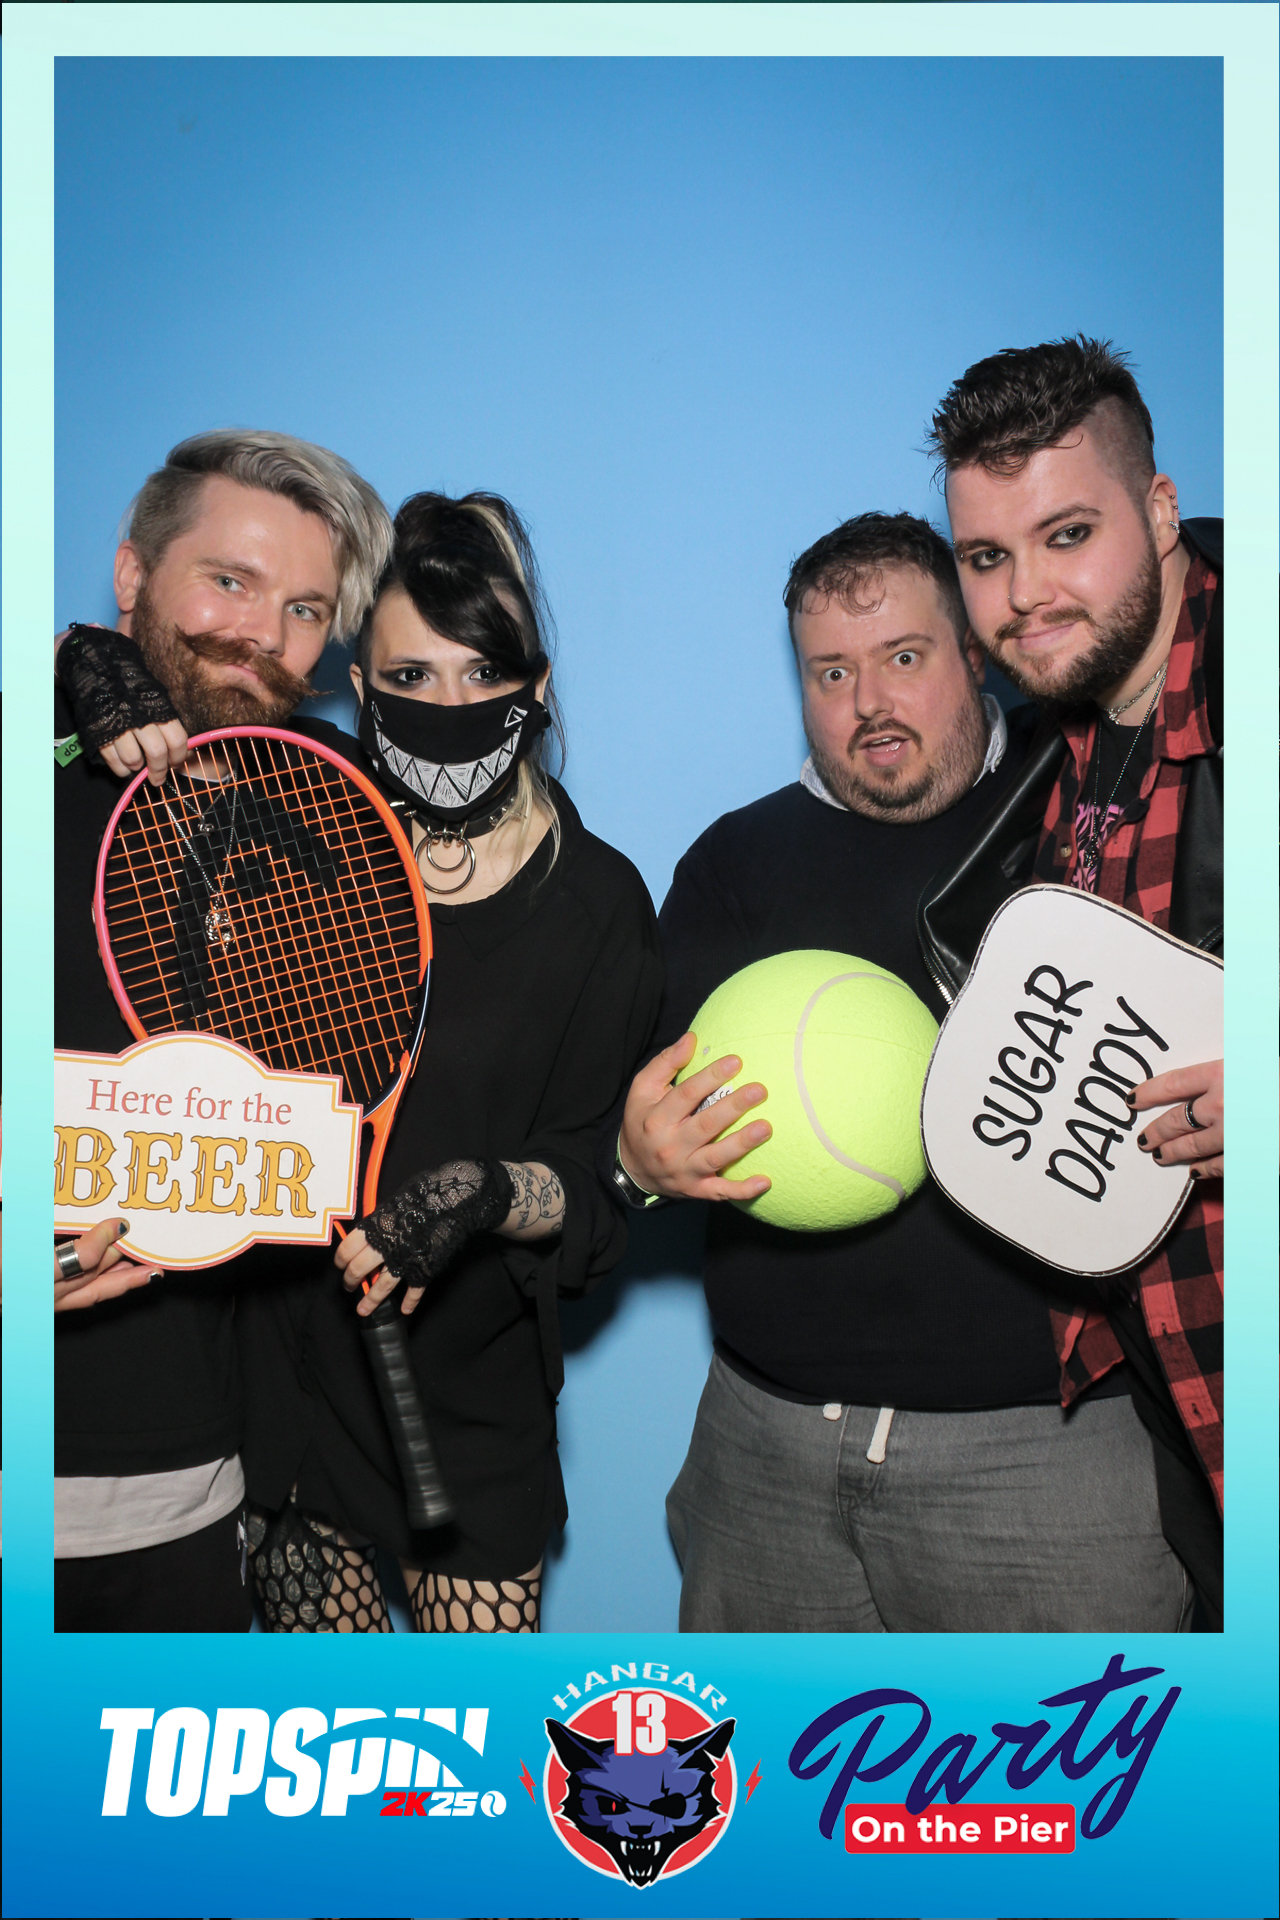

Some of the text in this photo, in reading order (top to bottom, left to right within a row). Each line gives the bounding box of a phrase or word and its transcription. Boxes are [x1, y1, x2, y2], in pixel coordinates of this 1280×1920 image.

[86, 1078, 292, 1125] Here for the
[972, 964, 1094, 1162] SUGAR
[1044, 995, 1170, 1203] DADDY
[54, 1125, 317, 1219] BEER
